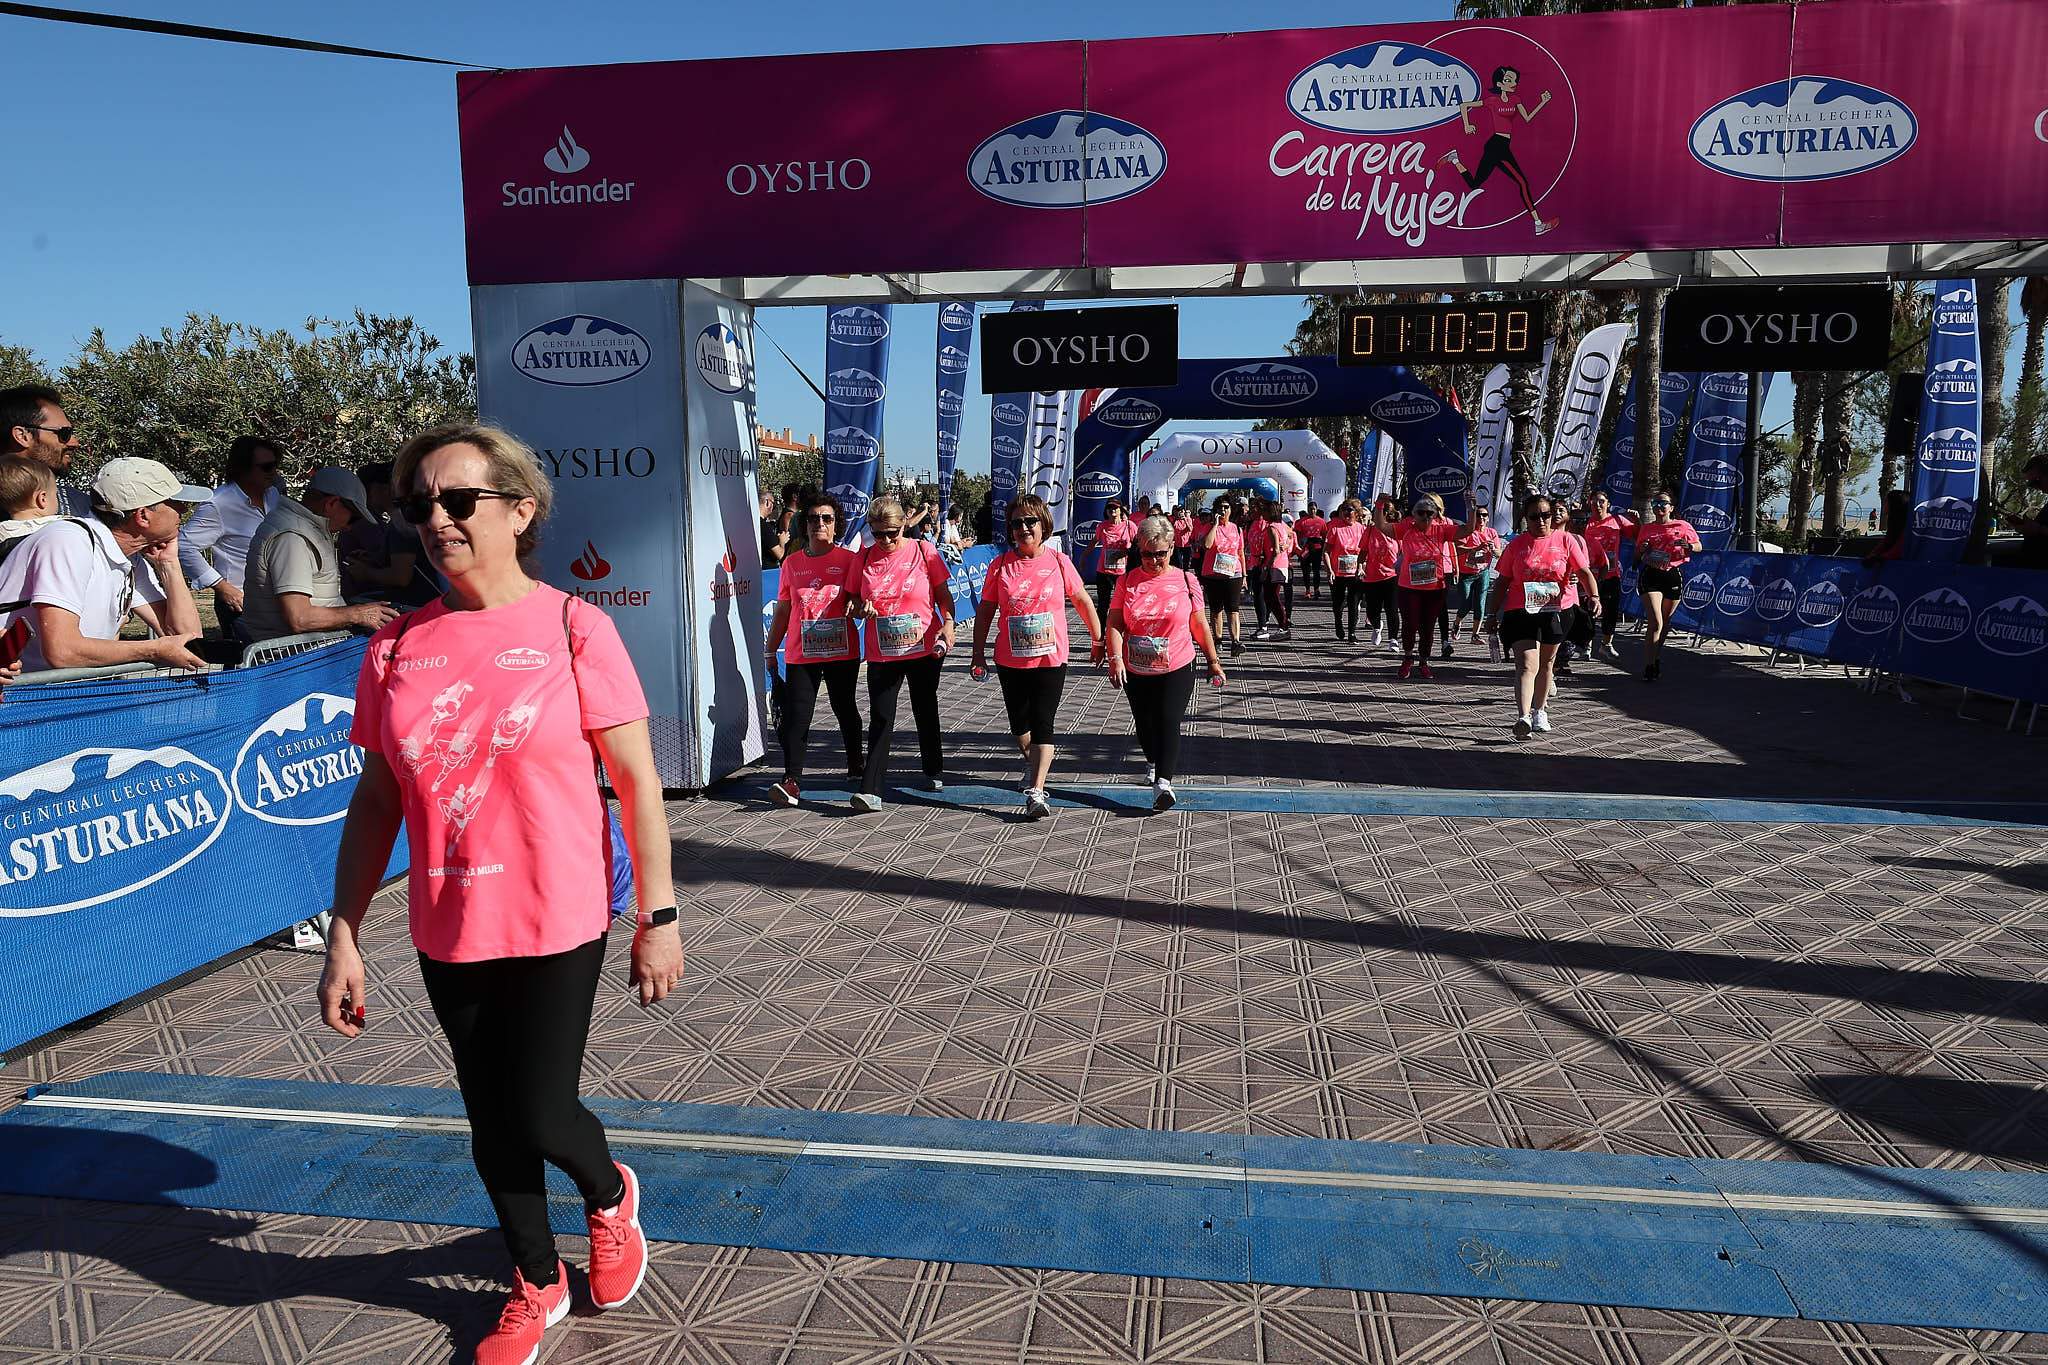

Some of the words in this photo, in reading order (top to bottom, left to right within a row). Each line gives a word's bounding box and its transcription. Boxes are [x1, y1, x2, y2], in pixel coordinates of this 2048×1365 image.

[1331, 73, 1392, 84] CENTRAL
[1397, 70, 1460, 81] LECHERA
[1301, 78, 1464, 113] ASTURIANA
[1741, 112, 1812, 125] CENTRAL
[1819, 109, 1894, 122] LECHERA
[1012, 144, 1074, 156] CENTRAL
[1704, 118, 1899, 157] ASTURIANA
[1268, 130, 1426, 177] Carrera
[726, 158, 872, 196] OYSHO
[982, 149, 1151, 185] ASTURIANA
[502, 178, 635, 207] Santander
[1305, 179, 1335, 211] de
[1341, 177, 1362, 211] la
[1355, 168, 1485, 247] Mujer
[830, 319, 883, 337] ASTURIANA
[1353, 311, 1529, 355] 01:10:38
[1700, 312, 1858, 345] OYSHO
[542, 338, 588, 348] CENTRAL
[591, 338, 636, 348] LECHERA
[1012, 333, 1151, 366] OYSHO
[522, 343, 642, 370] ASTURIANA
[1218, 376, 1310, 396] ASTURIANA
[1660, 379, 1685, 390] RIANA
[1704, 377, 1748, 396] ASTURIA
[1100, 408, 1158, 421] ASTURIANA
[1375, 403, 1437, 418] ASTURIANA
[1548, 351, 1611, 499] OYSHO
[1201, 437, 1283, 455] OYSHO
[535, 446, 656, 478] YSHO
[700, 445, 752, 478] OYSHO
[1075, 481, 1119, 494] ASTURIANA
[709, 579, 751, 602] Santander
[1799, 595, 1839, 617] ASTURIANA
[1847, 600, 1894, 624] ASTURIANA
[1907, 606, 1965, 631] ASTURIANA
[1979, 615, 2045, 645] ASTURIANA
[397, 655, 448, 673] OYSHO
[277, 735, 328, 758] CENTRAL
[255, 745, 366, 809] ASTURIA
[3, 793, 104, 830] CENTRAL
[111, 768, 200, 802] LECHERA
[477, 863, 504, 876] MUJER
